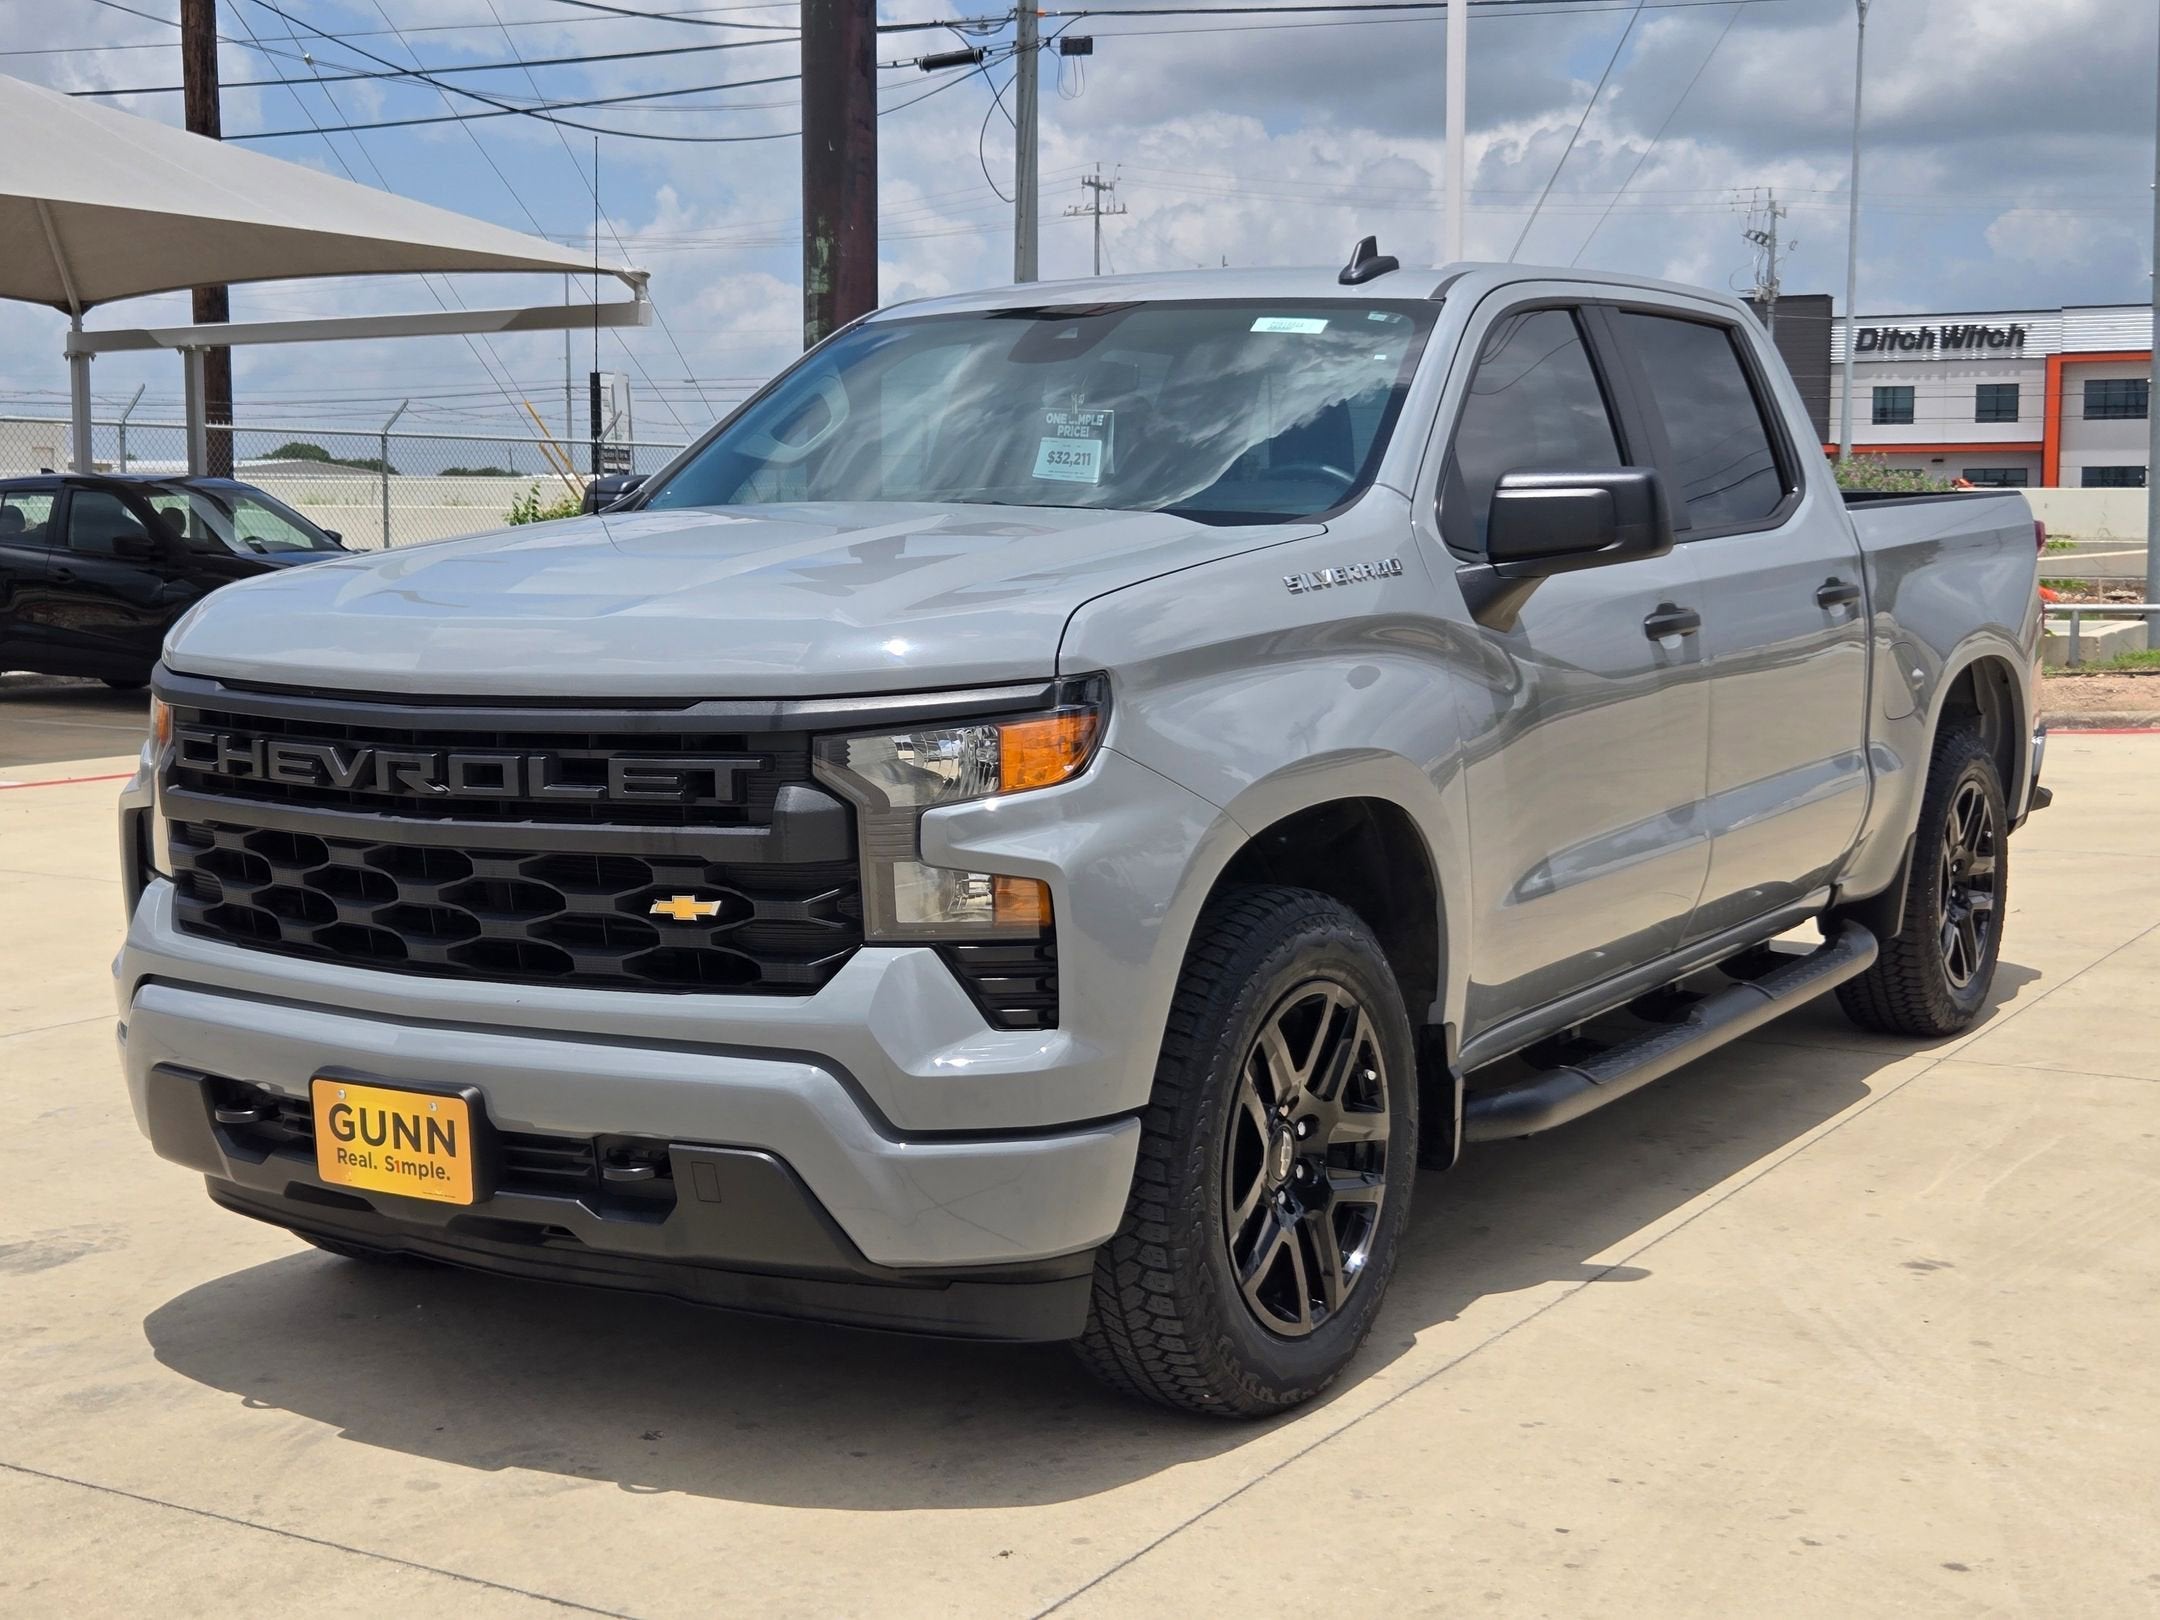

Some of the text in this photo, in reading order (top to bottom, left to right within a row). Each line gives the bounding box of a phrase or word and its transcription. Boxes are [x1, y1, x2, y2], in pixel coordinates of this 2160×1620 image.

[1855, 323, 2025, 352] Ditch Witch
[1046, 413, 1104, 426] ONE MPLE
[1057, 425, 1089, 437] PRICE!
[1047, 451, 1091, 467] $32,211
[1282, 558, 1403, 593] SILVERADO
[175, 728, 768, 801] CHEVROLET
[329, 1103, 456, 1157] GUNN
[336, 1147, 378, 1170] Real.
